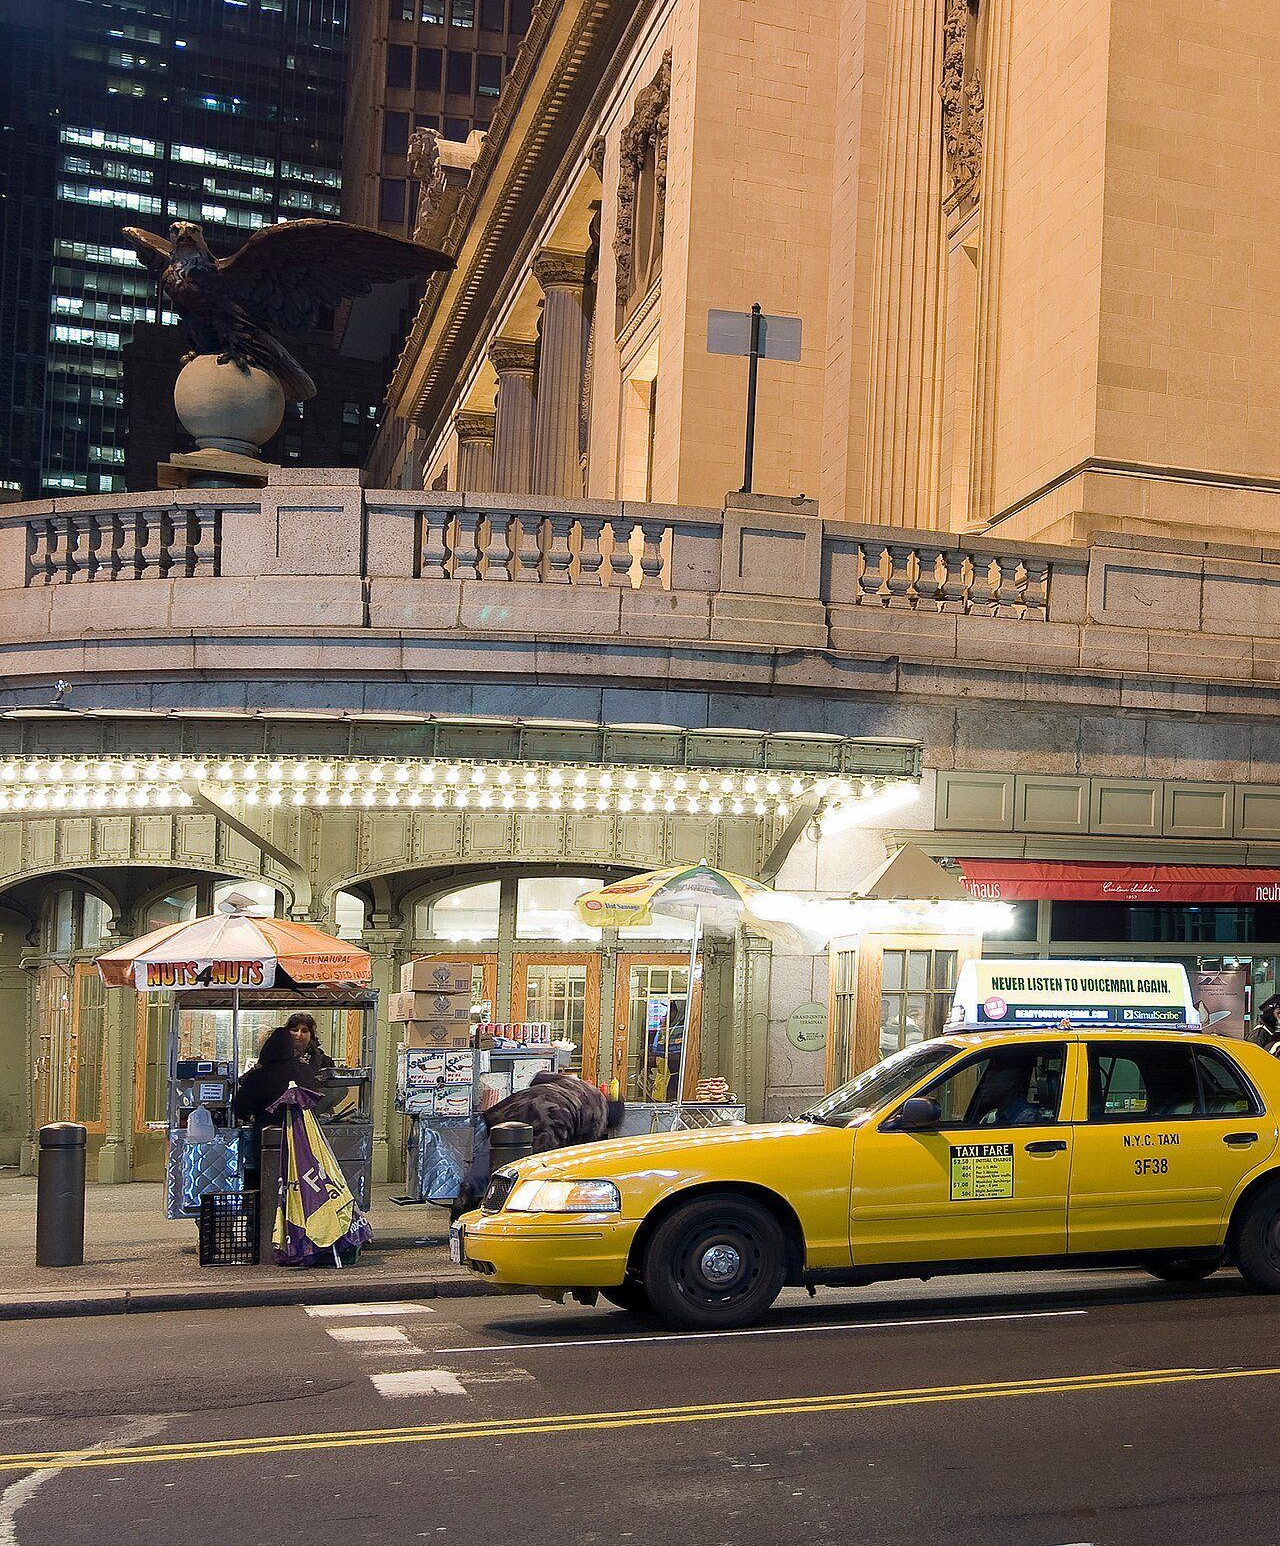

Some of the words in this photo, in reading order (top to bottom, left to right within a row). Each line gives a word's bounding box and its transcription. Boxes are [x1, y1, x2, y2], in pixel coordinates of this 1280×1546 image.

[317, 955, 351, 964] NATURAL
[991, 977, 1025, 991] NEVER
[1027, 977, 1062, 992] LISTEN
[1064, 978, 1078, 992] TO
[1081, 978, 1135, 993] VOICEMAIL
[1137, 979, 1171, 993] AGAIN.
[1123, 1134, 1155, 1147] N.Y.C.
[1157, 1134, 1180, 1145] TAXI
[956, 1146, 979, 1157] TAXI
[983, 1145, 1010, 1156] FARE
[1134, 1158, 1168, 1175] 3F38
